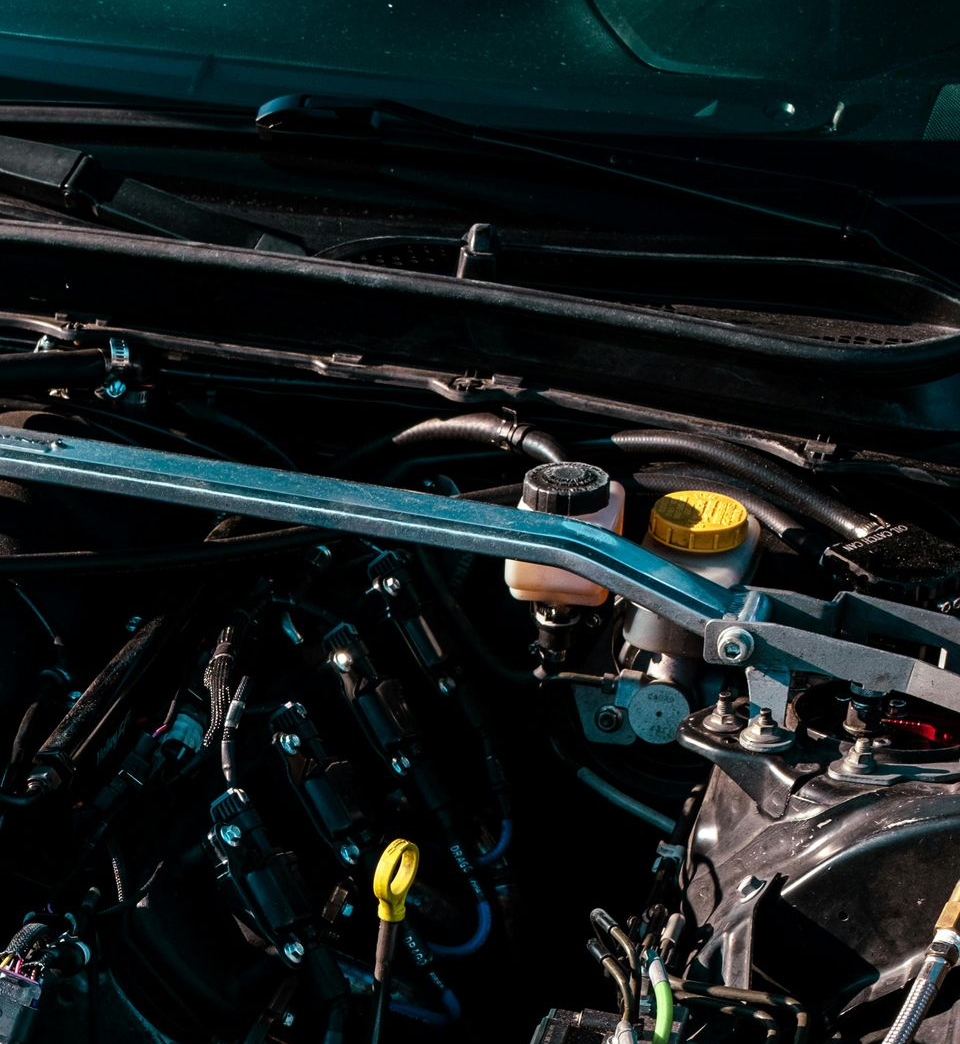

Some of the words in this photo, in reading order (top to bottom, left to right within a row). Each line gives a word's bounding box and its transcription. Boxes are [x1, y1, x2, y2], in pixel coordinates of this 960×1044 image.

[890, 523, 909, 535] OIL
[863, 530, 893, 545] CATCH
[842, 541, 864, 552] CAN
